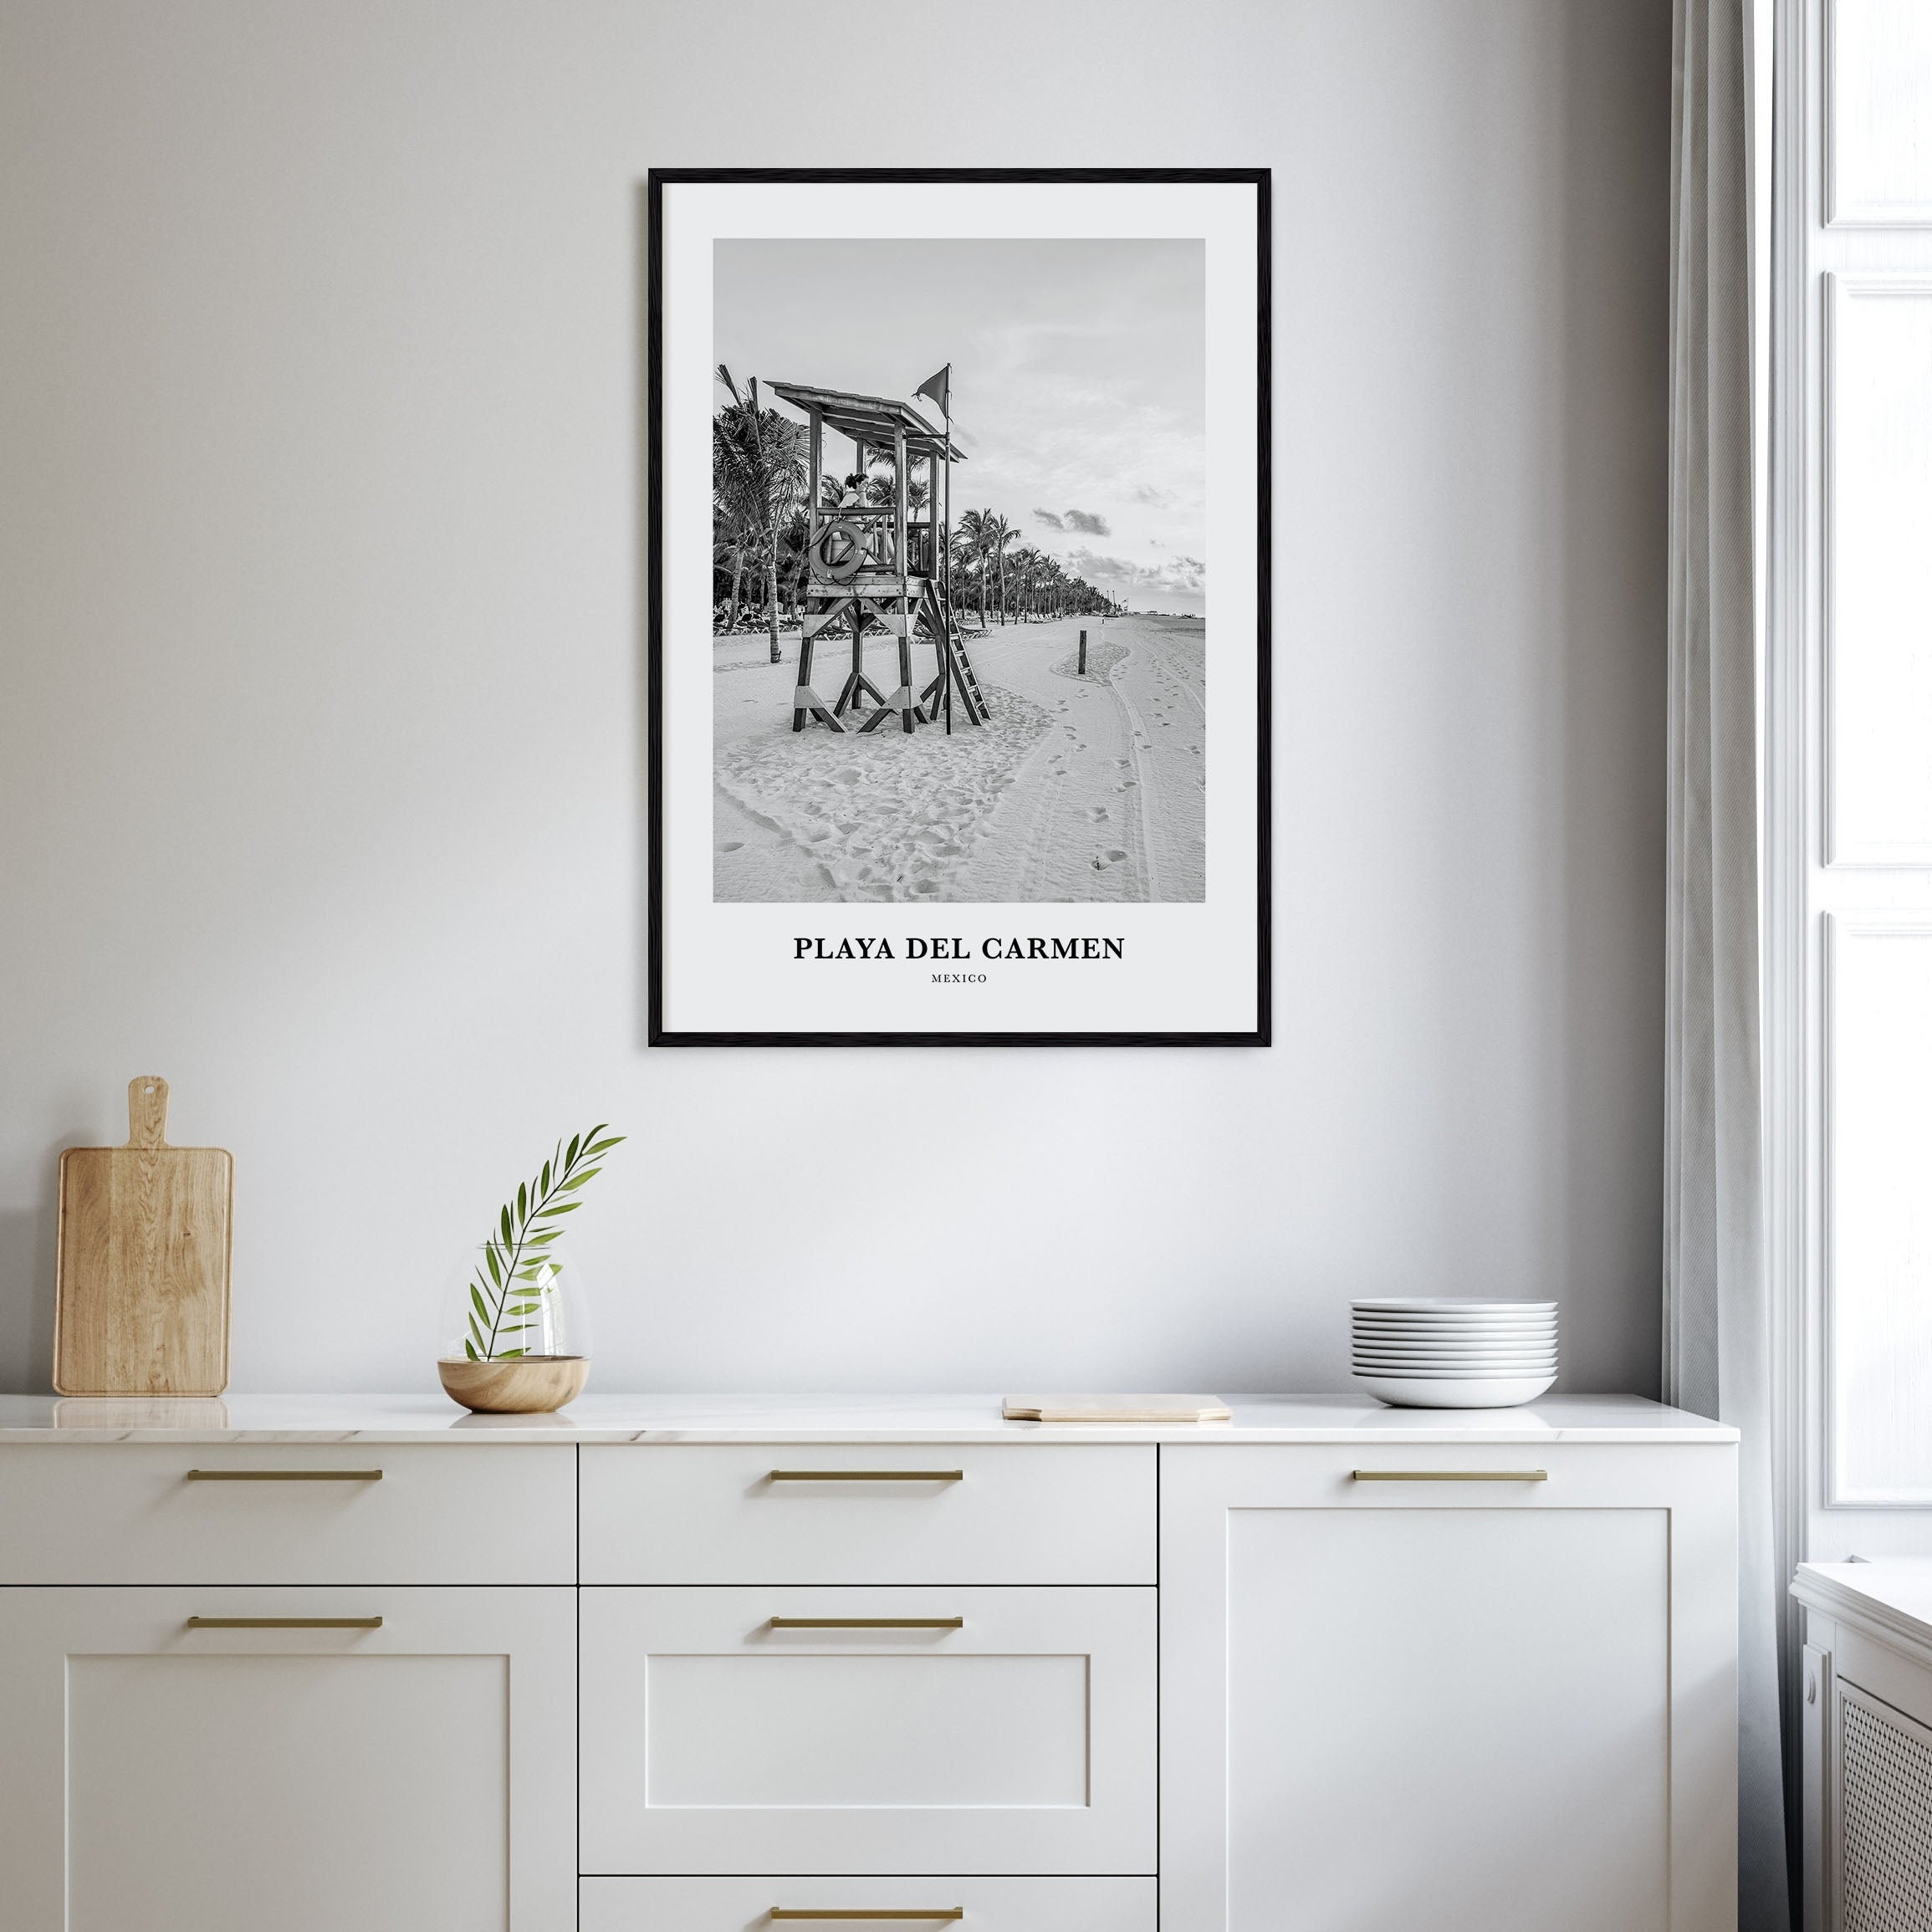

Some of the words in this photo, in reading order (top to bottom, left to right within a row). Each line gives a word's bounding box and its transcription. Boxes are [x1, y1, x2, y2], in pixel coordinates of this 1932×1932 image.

[793, 938, 896, 959] PLAYA
[905, 938, 971, 959] DEL
[981, 938, 1125, 960] CARMEN
[931, 974, 988, 984] MEXICO
